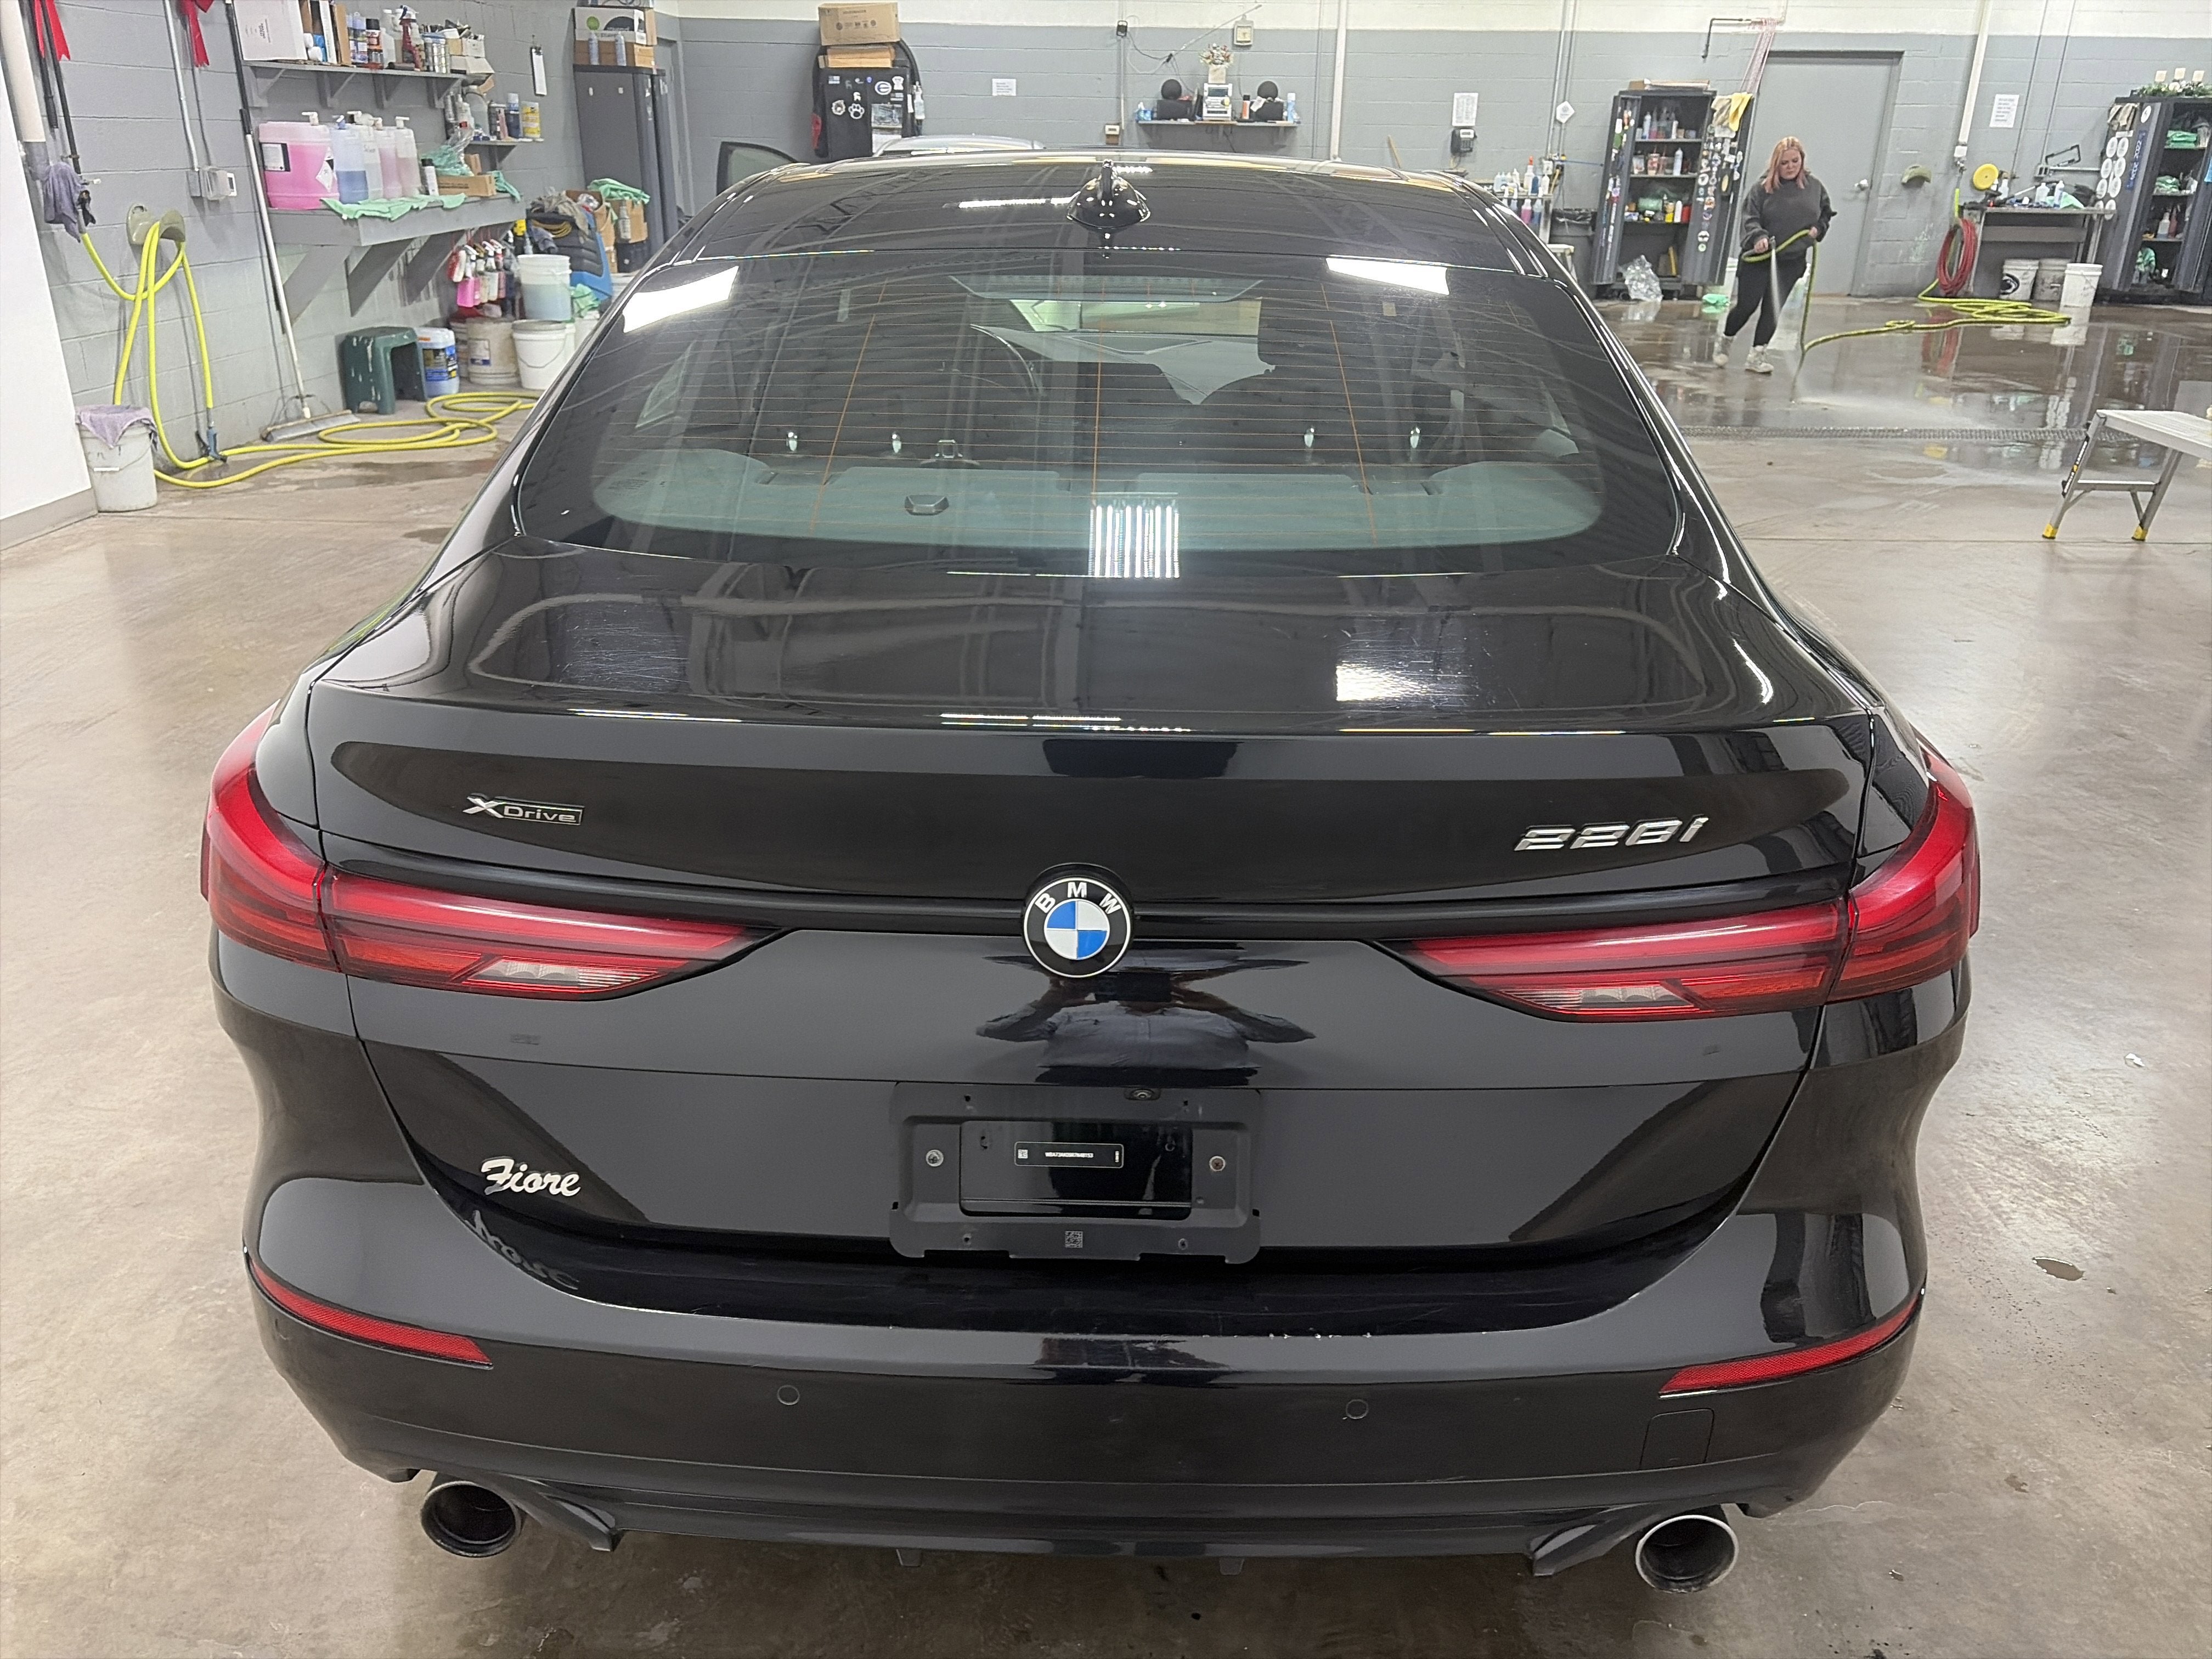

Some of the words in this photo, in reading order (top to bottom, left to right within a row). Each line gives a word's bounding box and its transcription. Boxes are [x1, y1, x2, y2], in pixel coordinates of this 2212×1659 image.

[1514, 816, 1709, 851] 228i
[1035, 882, 1122, 915] BMW
[481, 1158, 582, 1197] Fiore
